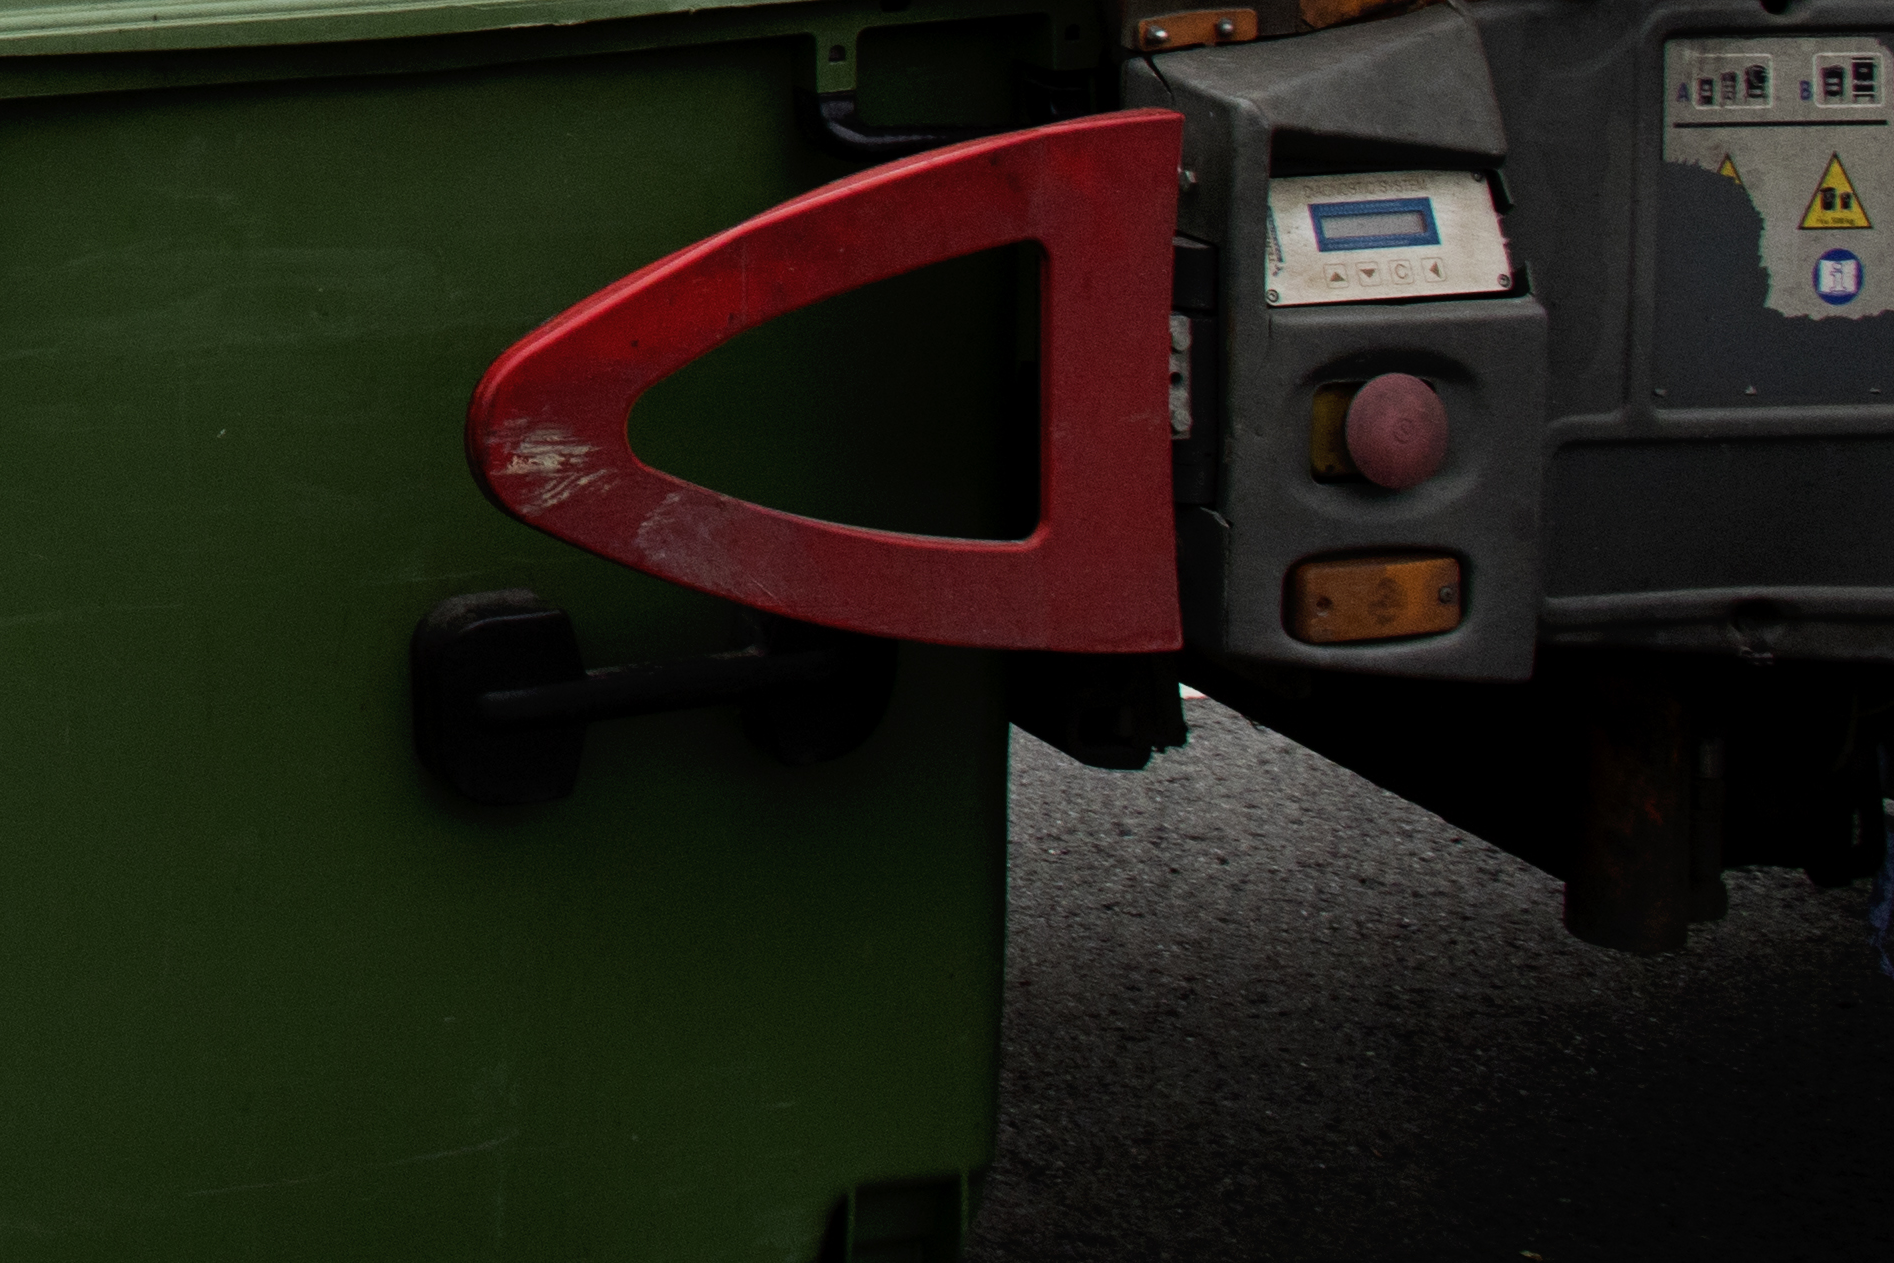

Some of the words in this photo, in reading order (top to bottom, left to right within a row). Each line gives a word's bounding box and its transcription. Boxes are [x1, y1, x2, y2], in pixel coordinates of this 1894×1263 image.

[1677, 82, 1690, 101] A
[1799, 80, 1812, 101] B
[1394, 263, 1409, 280] C
